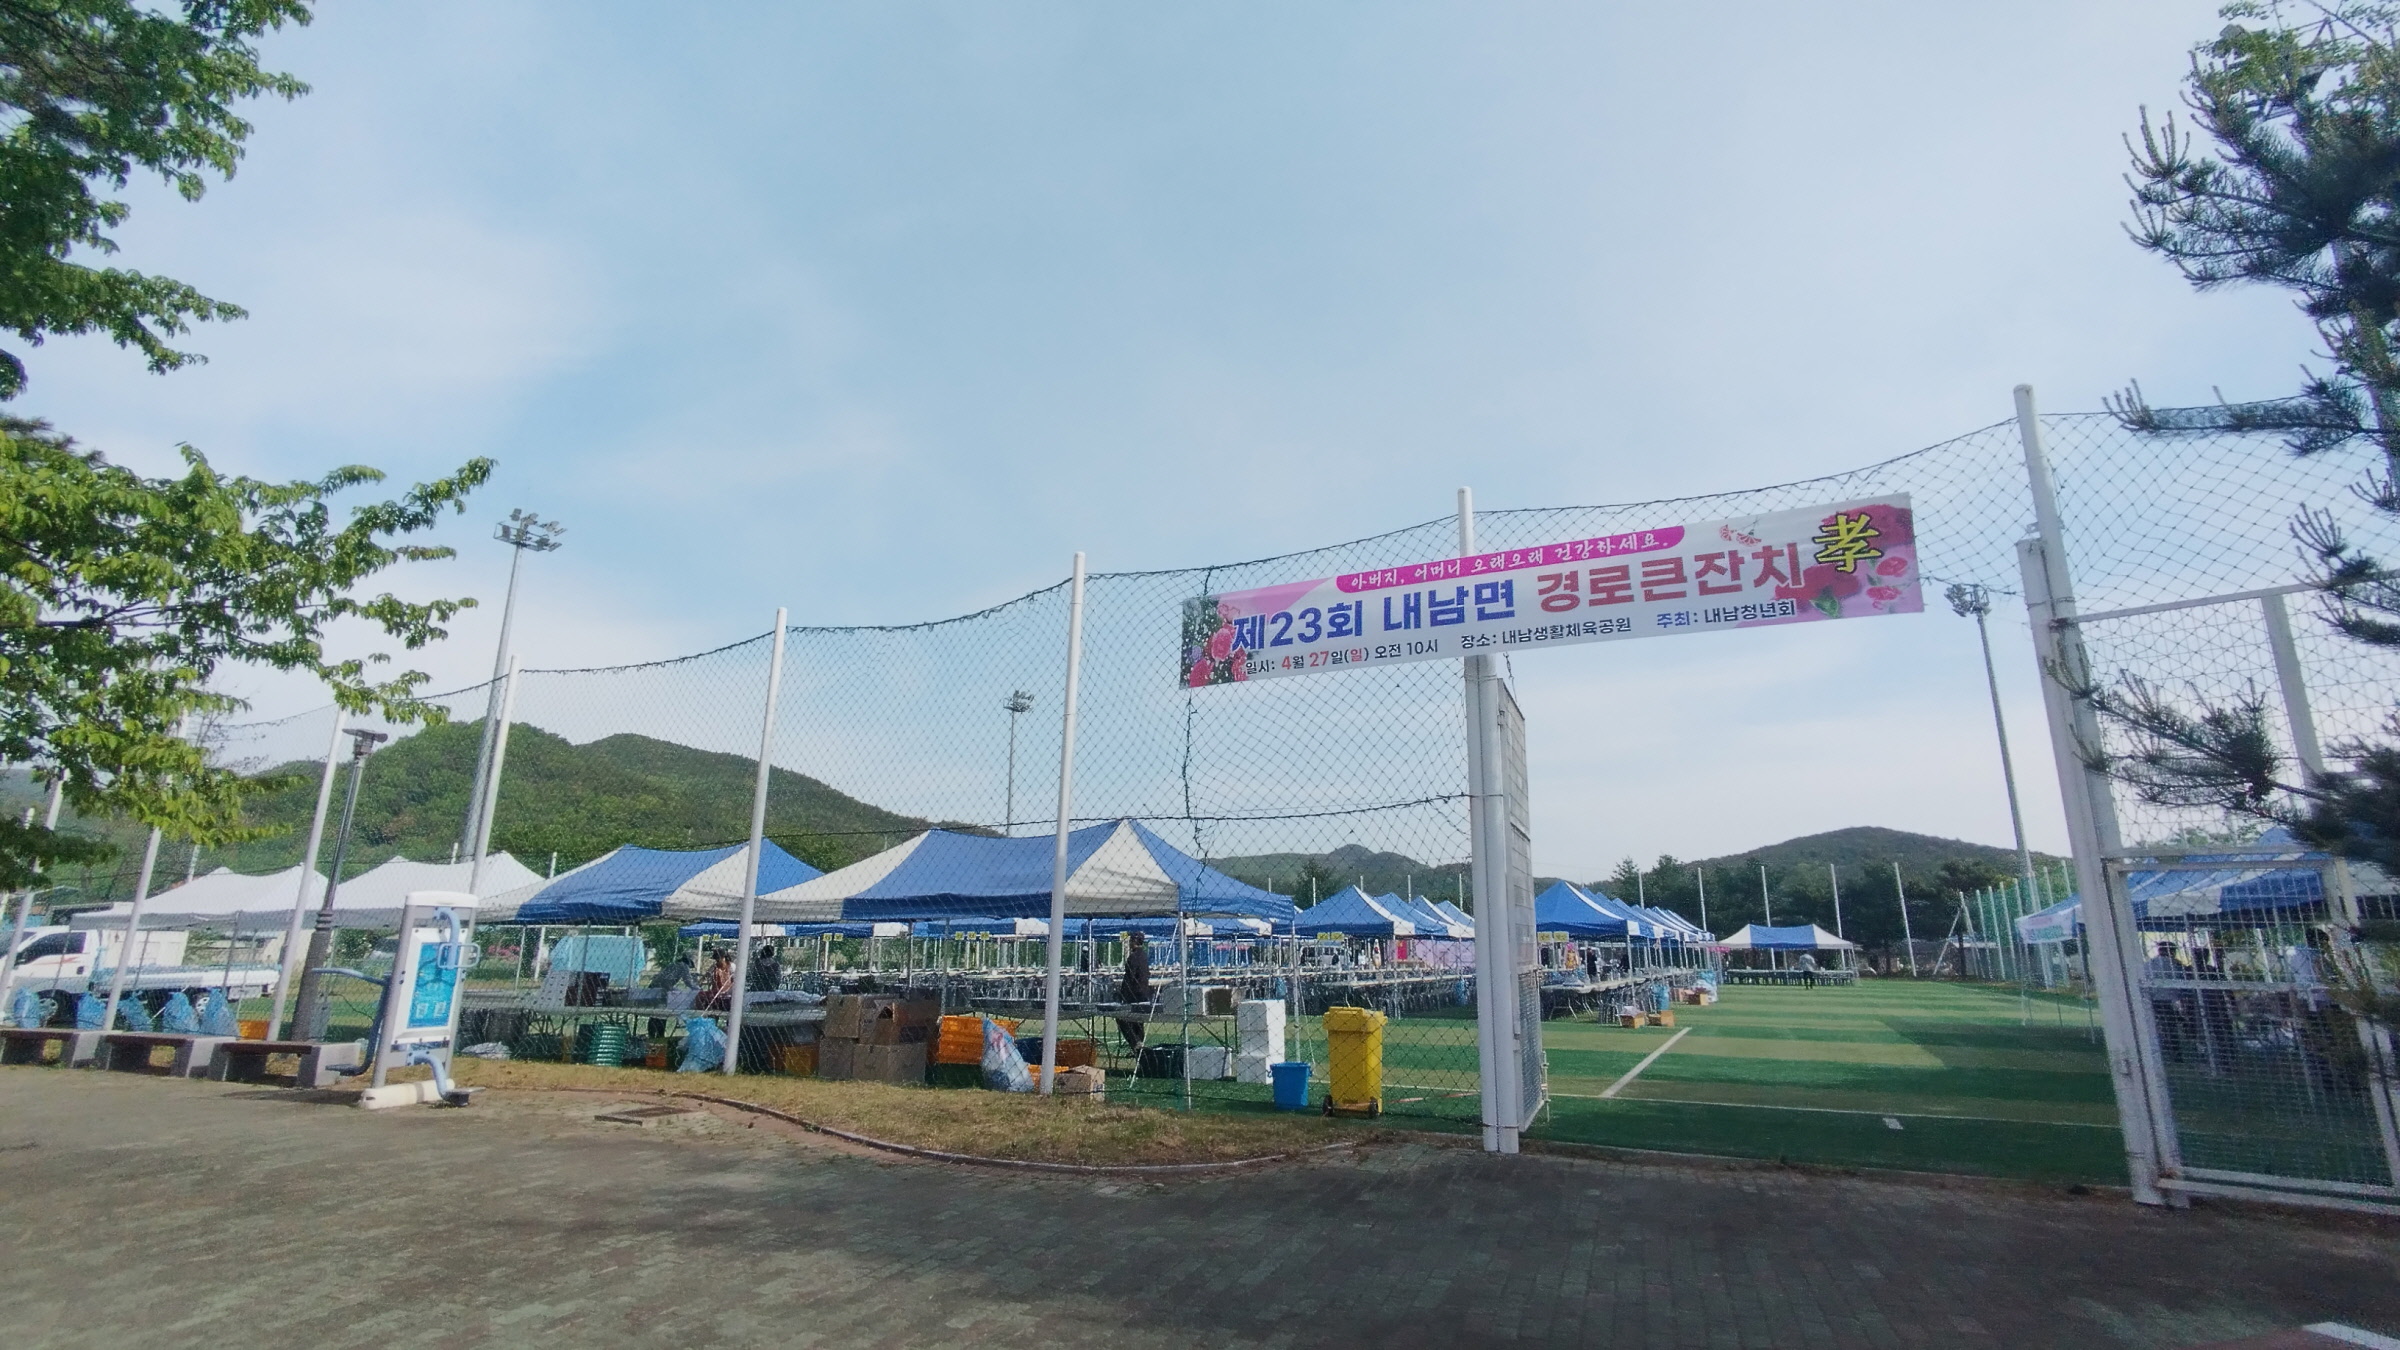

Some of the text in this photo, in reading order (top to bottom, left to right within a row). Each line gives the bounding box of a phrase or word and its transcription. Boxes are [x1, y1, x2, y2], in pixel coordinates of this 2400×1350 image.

[1351, 532, 1669, 590] 아버지, 어머니 오래오래 건강하세요.
[1813, 512, 1883, 574] 孝
[1232, 542, 1804, 651] 제23회 내남면 경로큰잔치
[1656, 599, 1796, 629] 주최: 내남청년회
[1461, 617, 1632, 649] 장소: 내남생활체육공원
[1245, 639, 1439, 675] 일시: 4월 27일(일) 오전 10시
